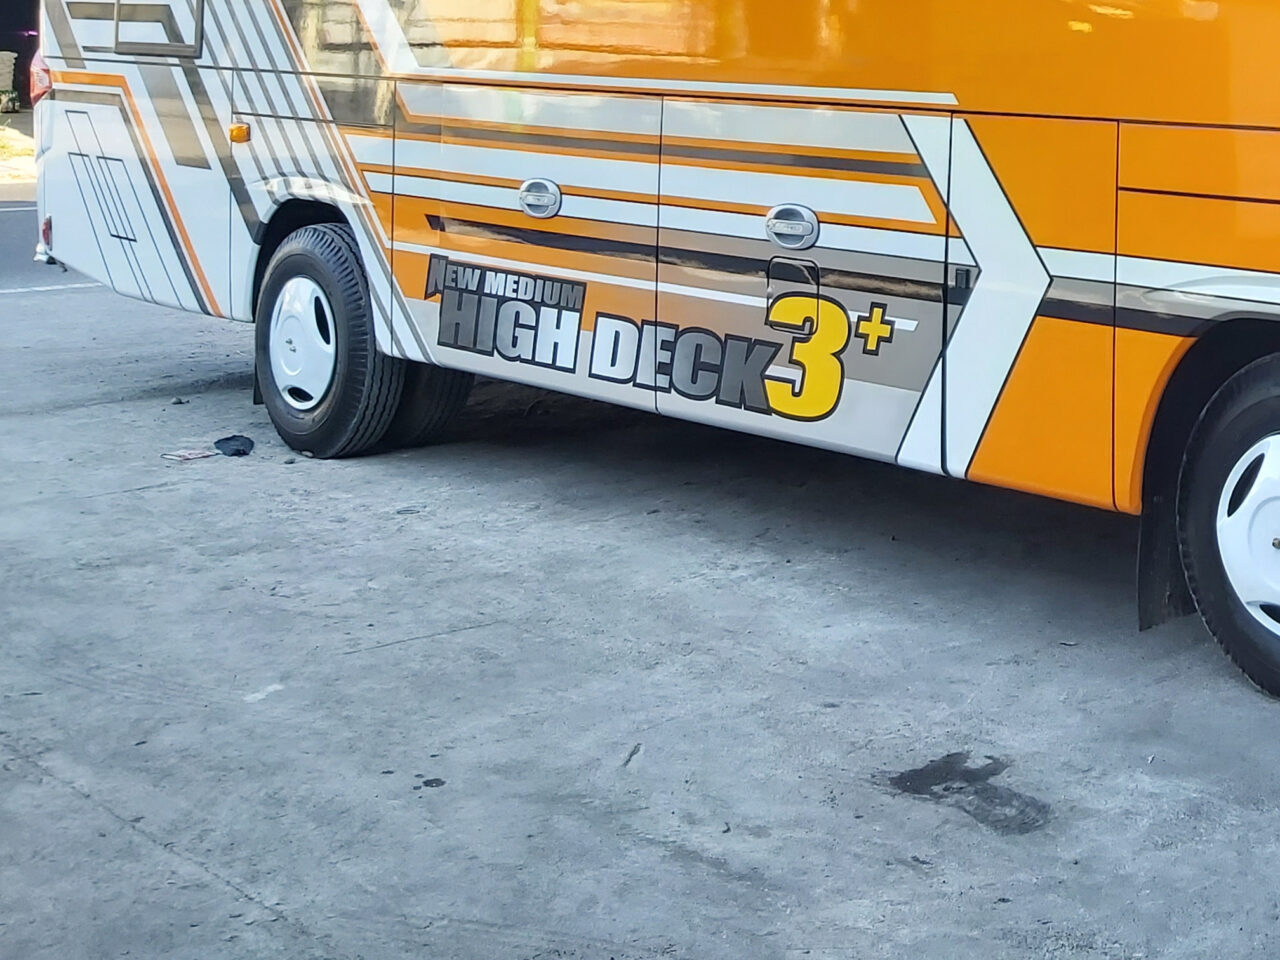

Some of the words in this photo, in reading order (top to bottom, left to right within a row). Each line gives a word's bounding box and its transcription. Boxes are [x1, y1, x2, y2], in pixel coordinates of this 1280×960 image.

[426, 254, 481, 298] NEW
[483, 270, 586, 308] MEDIUM
[438, 290, 580, 373] HIGH
[589, 312, 783, 415] DECK
